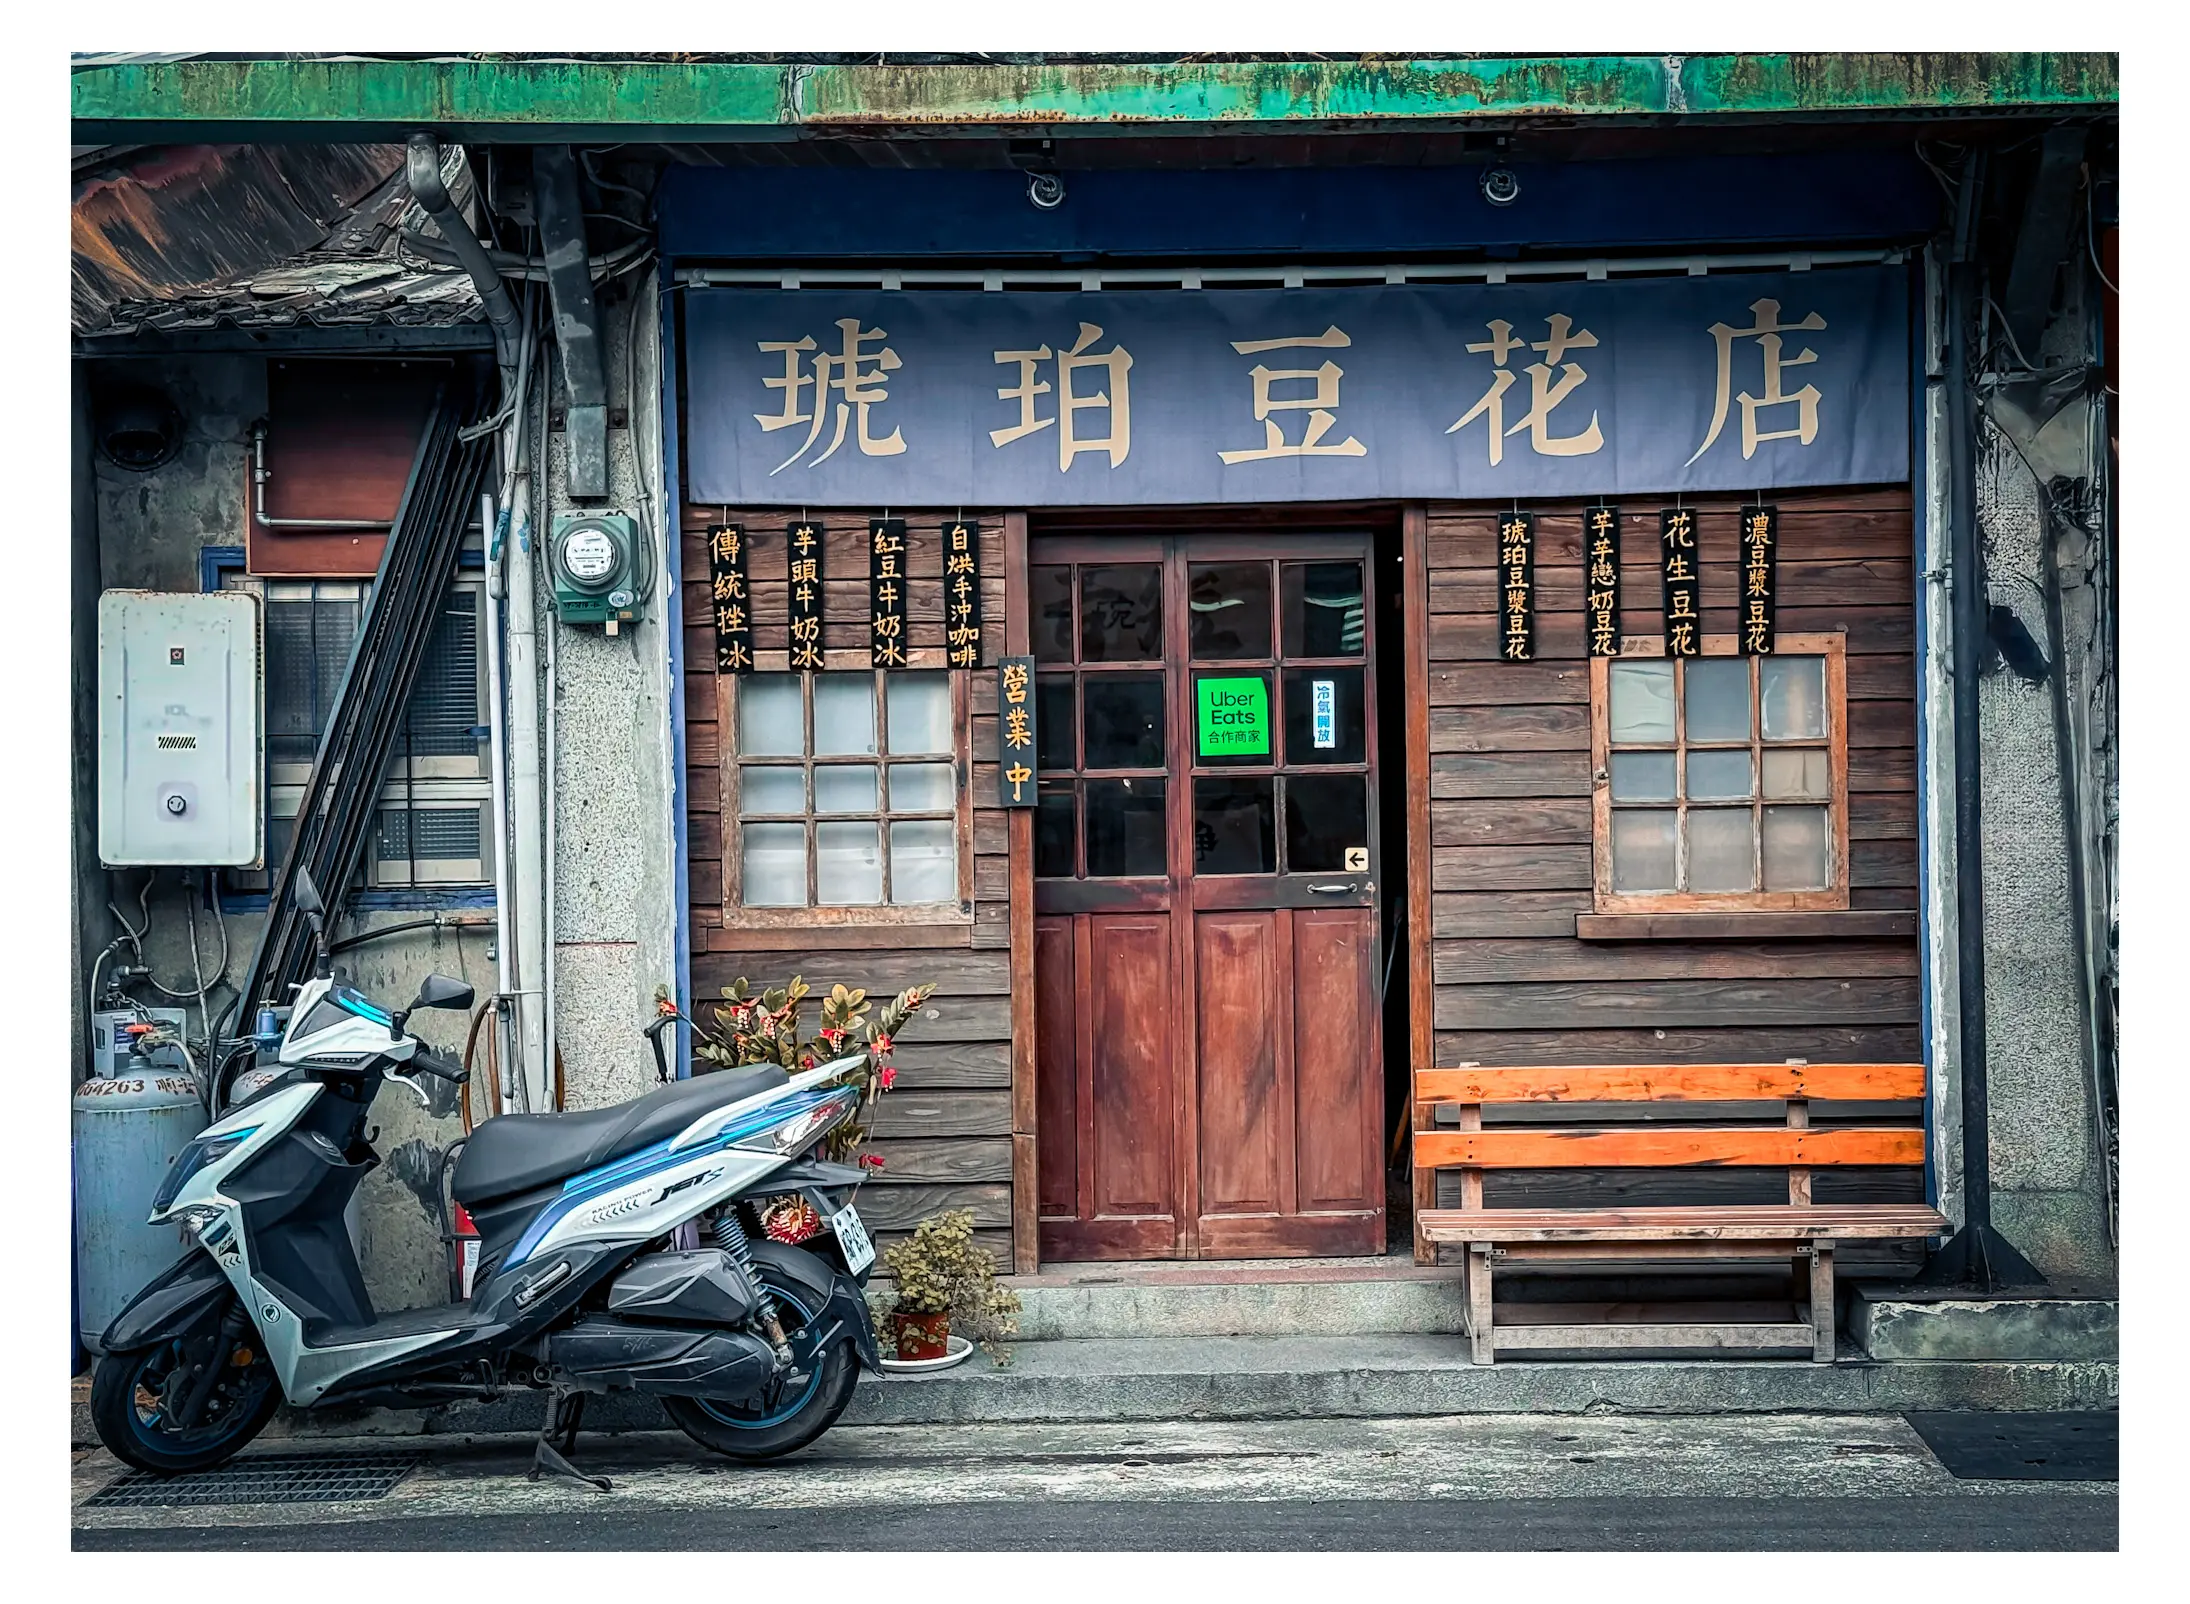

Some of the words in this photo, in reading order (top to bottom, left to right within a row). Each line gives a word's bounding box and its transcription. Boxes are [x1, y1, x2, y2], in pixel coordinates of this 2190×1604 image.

[753, 298, 1827, 476] 琥珀豆花店
[709, 528, 752, 668] 傳統挫冰
[791, 526, 825, 668] 芋頭牛奶冰
[873, 528, 906, 666] 紅豆牛奶冰
[947, 525, 979, 668] 自烘手沖咖啡
[1502, 518, 1531, 660] 琥珀豆漿豆花
[1588, 510, 1617, 656] 芋芋戀奶豆花
[1663, 511, 1697, 655] 花生豆花
[1744, 512, 1773, 654] 濃豆漿豆花
[1003, 663, 1033, 802] 營業中
[1208, 729, 1261, 744] 合作商家
[1210, 690, 1254, 707] Uber
[1211, 709, 1256, 725] Eats
[1317, 685, 1331, 742] 冷氣開放
